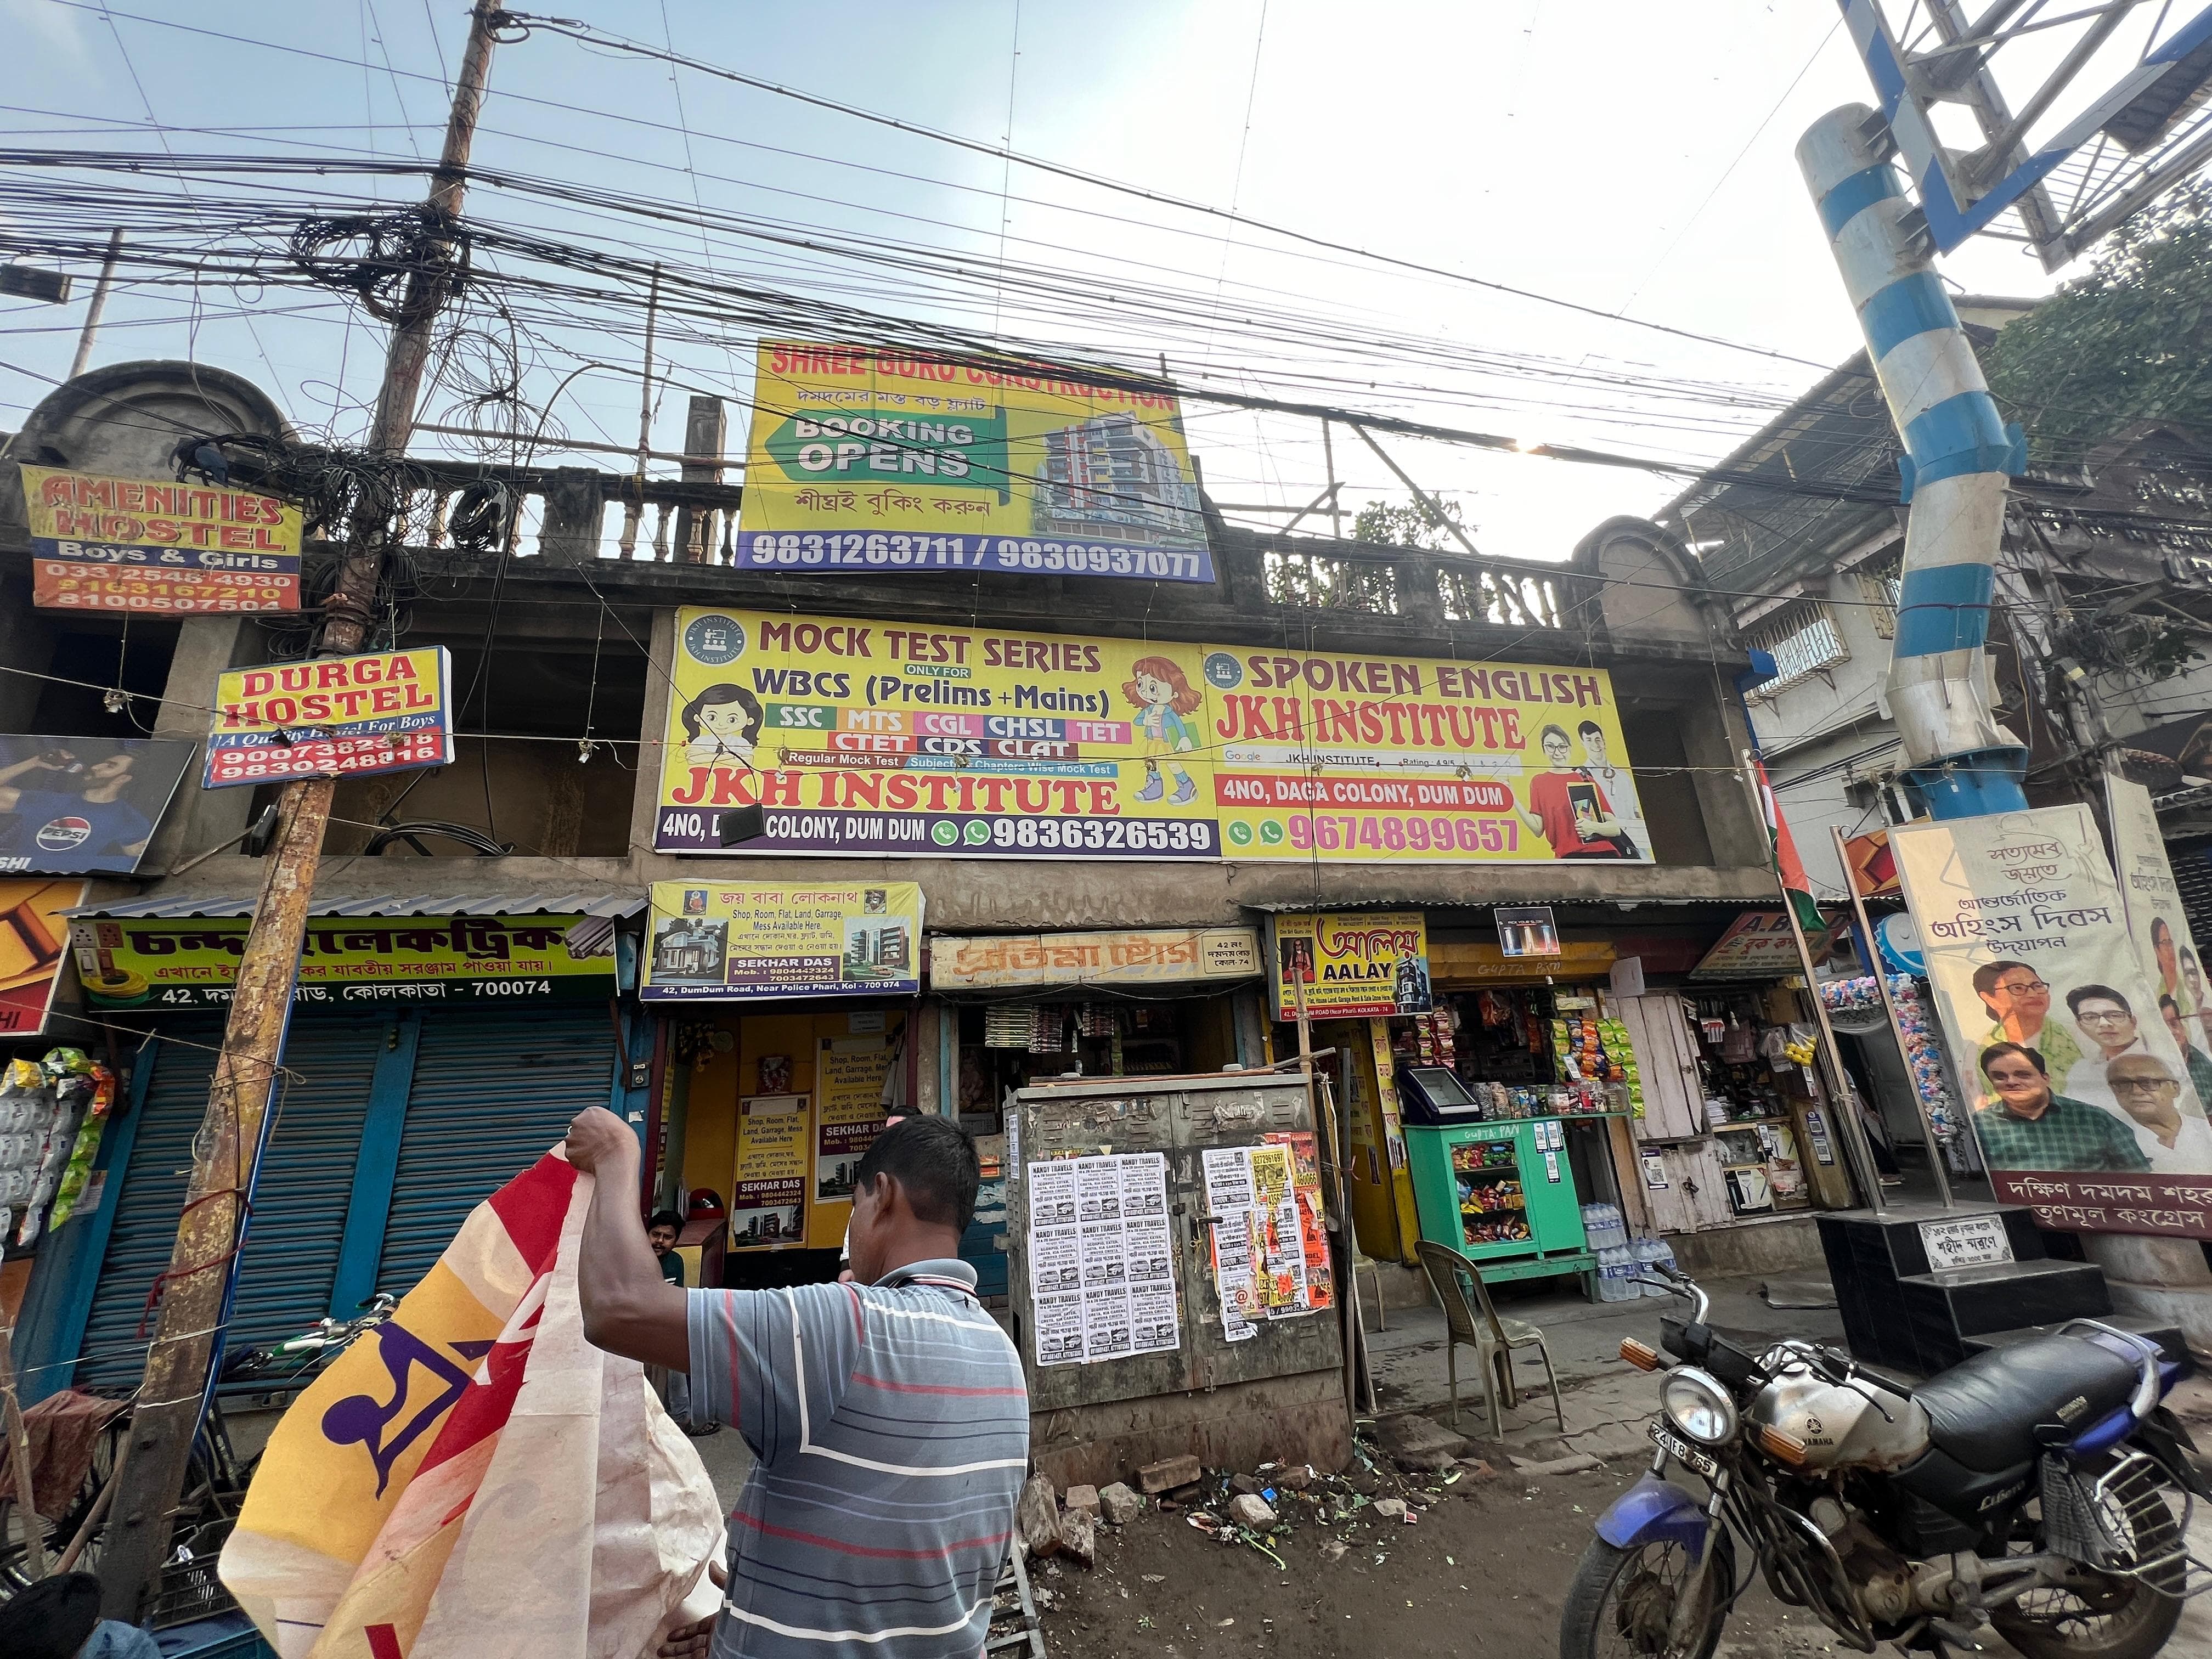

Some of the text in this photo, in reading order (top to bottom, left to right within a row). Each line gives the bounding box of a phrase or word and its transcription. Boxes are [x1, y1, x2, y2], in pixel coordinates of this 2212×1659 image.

[771, 343, 868, 375] SHREE
[877, 347, 957, 382] GURU
[797, 391, 870, 402] দমদমের
[876, 391, 906, 404] মস্ত
[915, 397, 940, 409] বড়
[795, 417, 975, 445] BOOKING
[798, 443, 970, 477] OPENS
[41, 476, 284, 525] AMENITIES
[794, 488, 991, 517] শীঘ্রই বুকিং করুন
[56, 510, 286, 551] HOSTEL
[58, 541, 279, 569] Boys & Girls
[752, 534, 1200, 579] 9831263711 9830937077
[47, 565, 291, 588] 033 2548 4930
[58, 579, 281, 599] 9163167210
[58, 594, 282, 611] 8100507504
[760, 621, 872, 657] MOCK
[883, 630, 972, 664] TEST
[984, 638, 1101, 673] SERIES
[242, 656, 416, 697] DURGA
[907, 665, 969, 678] ONLY FOR
[1248, 656, 1422, 695] SPOKEN
[1436, 667, 1602, 708] ENGLISH
[223, 683, 433, 727] HOSTEL
[752, 668, 1109, 719] WBCS (Prelims +Mains)
[222, 715, 435, 746] A For Boys
[780, 707, 1121, 741] SSC MTS CGL CHSL TET
[1216, 694, 1526, 750] JKH INSTITUTE
[835, 734, 1070, 760] CTET CDS CLAT
[1225, 750, 1261, 762] Google
[1285, 754, 1313, 764] JKH
[1313, 754, 1374, 765] INSTITUTE
[221, 746, 435, 778] 9830248816
[789, 752, 836, 765] Regular
[839, 755, 871, 766] Mock
[874, 756, 899, 766] Test
[975, 760, 1025, 772] Chapters
[1057, 763, 1086, 774] Mock
[1088, 764, 1110, 775] Test
[672, 767, 1120, 815] JKH INSTITUTE
[1223, 780, 1504, 808] 4NO, DAGA COLONY, DUM DUM
[42, 827, 86, 840] PEPSI
[662, 813, 706, 842] 4NO,
[767, 815, 840, 845] COLONY,
[845, 817, 885, 840] DUM
[888, 818, 925, 842] DUM
[994, 819, 1211, 850] 9836326539
[1288, 815, 1518, 851] 9674899657
[1987, 842, 2062, 866] সত্যমেব
[2000, 864, 2072, 884] জয়তে
[720, 890, 858, 906] জয় বাবা লোকনাথ
[1958, 888, 2067, 910] আন্তর্জাতিক
[732, 909, 843, 921] Shop, Room, Flat, Land, Garrage,
[753, 920, 822, 931] Mess Available Here.
[1929, 905, 2112, 938] অহিংস দিবস
[1316, 917, 1420, 961] আলয়
[154, 964, 212, 980] এখানে
[331, 960, 393, 977] যাবতীয়
[399, 962, 456, 976] সরঞ্জাম
[463, 960, 512, 974] পাওয়া
[737, 958, 832, 968] SEKHAR DAS
[1323, 963, 1393, 981] AALAY
[161, 990, 198, 1005] 42,
[343, 981, 446, 1001] কোলকাতা
[472, 980, 551, 996] 700074
[662, 987, 678, 996] 42,
[680, 986, 725, 994] DumDum
[727, 985, 753, 994] Road,
[781, 984, 811, 992] Police
[813, 983, 839, 991] Phari,
[826, 1125, 869, 1136] SEKHAR
[1500, 1123, 1520, 1138] PAN
[1033, 1165, 1050, 1173] NANDY
[1078, 1161, 1096, 1170] NANDY
[1254, 1153, 1283, 1165] 8272961697
[741, 1180, 800, 1192] SEKHAR DAS
[2007, 1177, 2071, 1199] দক্ষিণ
[2076, 1184, 2153, 1203] দমদম
[2030, 1204, 2206, 1229] তৃণমূল কংগ্রেস
[1937, 1236, 1964, 1255] শহীদ
